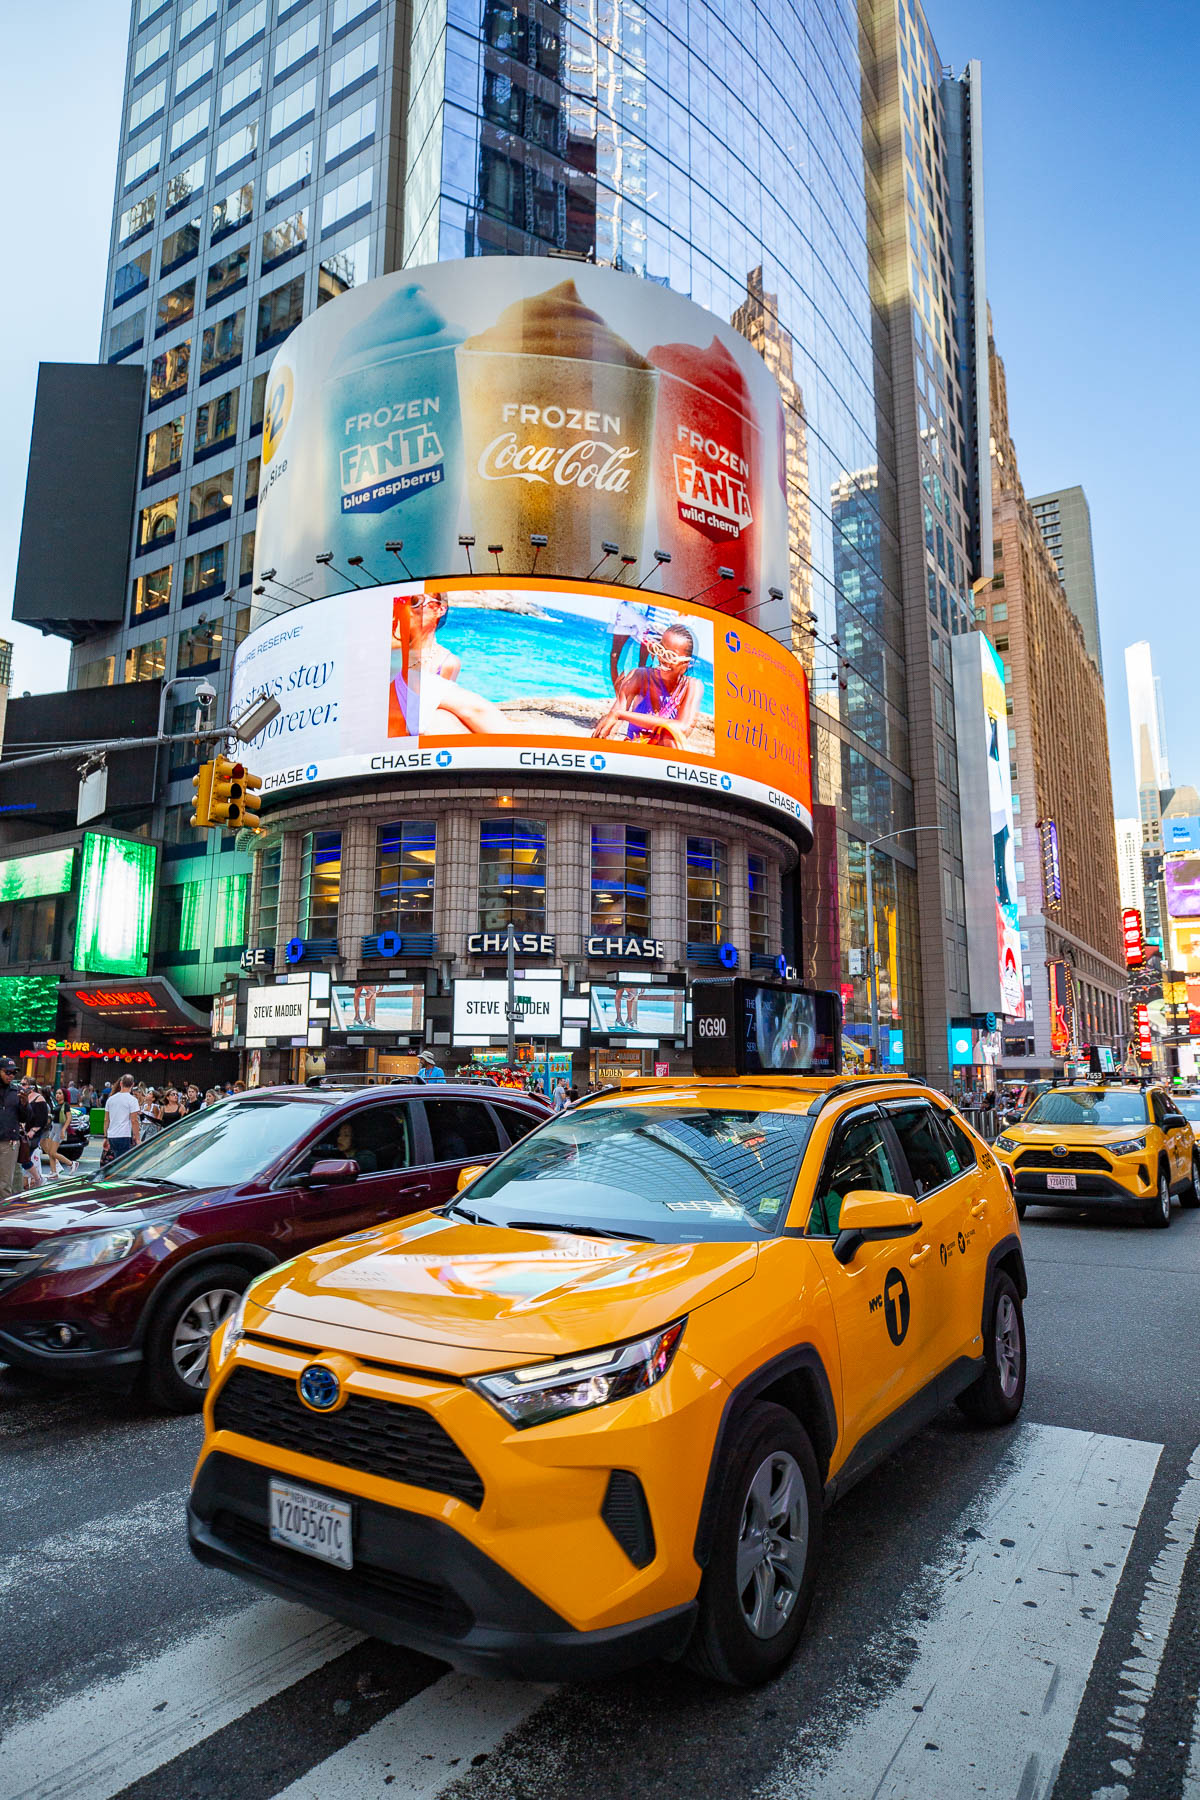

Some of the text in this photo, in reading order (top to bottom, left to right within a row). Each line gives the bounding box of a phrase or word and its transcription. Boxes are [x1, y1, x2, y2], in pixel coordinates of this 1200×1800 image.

[345, 396, 441, 435] FROZEN
[502, 402, 622, 436] FROZEN
[341, 423, 444, 490] FANTA
[477, 431, 639, 494] Coca-Cola
[677, 424, 749, 479] FROZEN
[270, 459, 288, 487] Size
[343, 469, 442, 511] blue raspberry
[674, 453, 752, 524] FANTA
[681, 506, 740, 539] wild cherry
[257, 625, 301, 654] RESERVE
[287, 660, 334, 692] stay
[726, 671, 777, 716] Some
[726, 719, 768, 752] with
[769, 737, 795, 768] you
[371, 752, 432, 770] CHASE
[519, 752, 586, 768] CHASE
[264, 768, 304, 790] CHASE
[666, 765, 718, 787] CHASE
[768, 791, 795, 814] CHASE
[468, 933, 555, 954] CHASE
[588, 937, 665, 959] CHASE
[75, 989, 157, 1007] Subway
[253, 1004, 302, 1019] STEVE MADDEN
[466, 1001, 500, 1015] STEVE
[698, 1018, 727, 1037] 6G90
[868, 1294, 883, 1314] NYC
[276, 1499, 343, 1549] Y205567C
